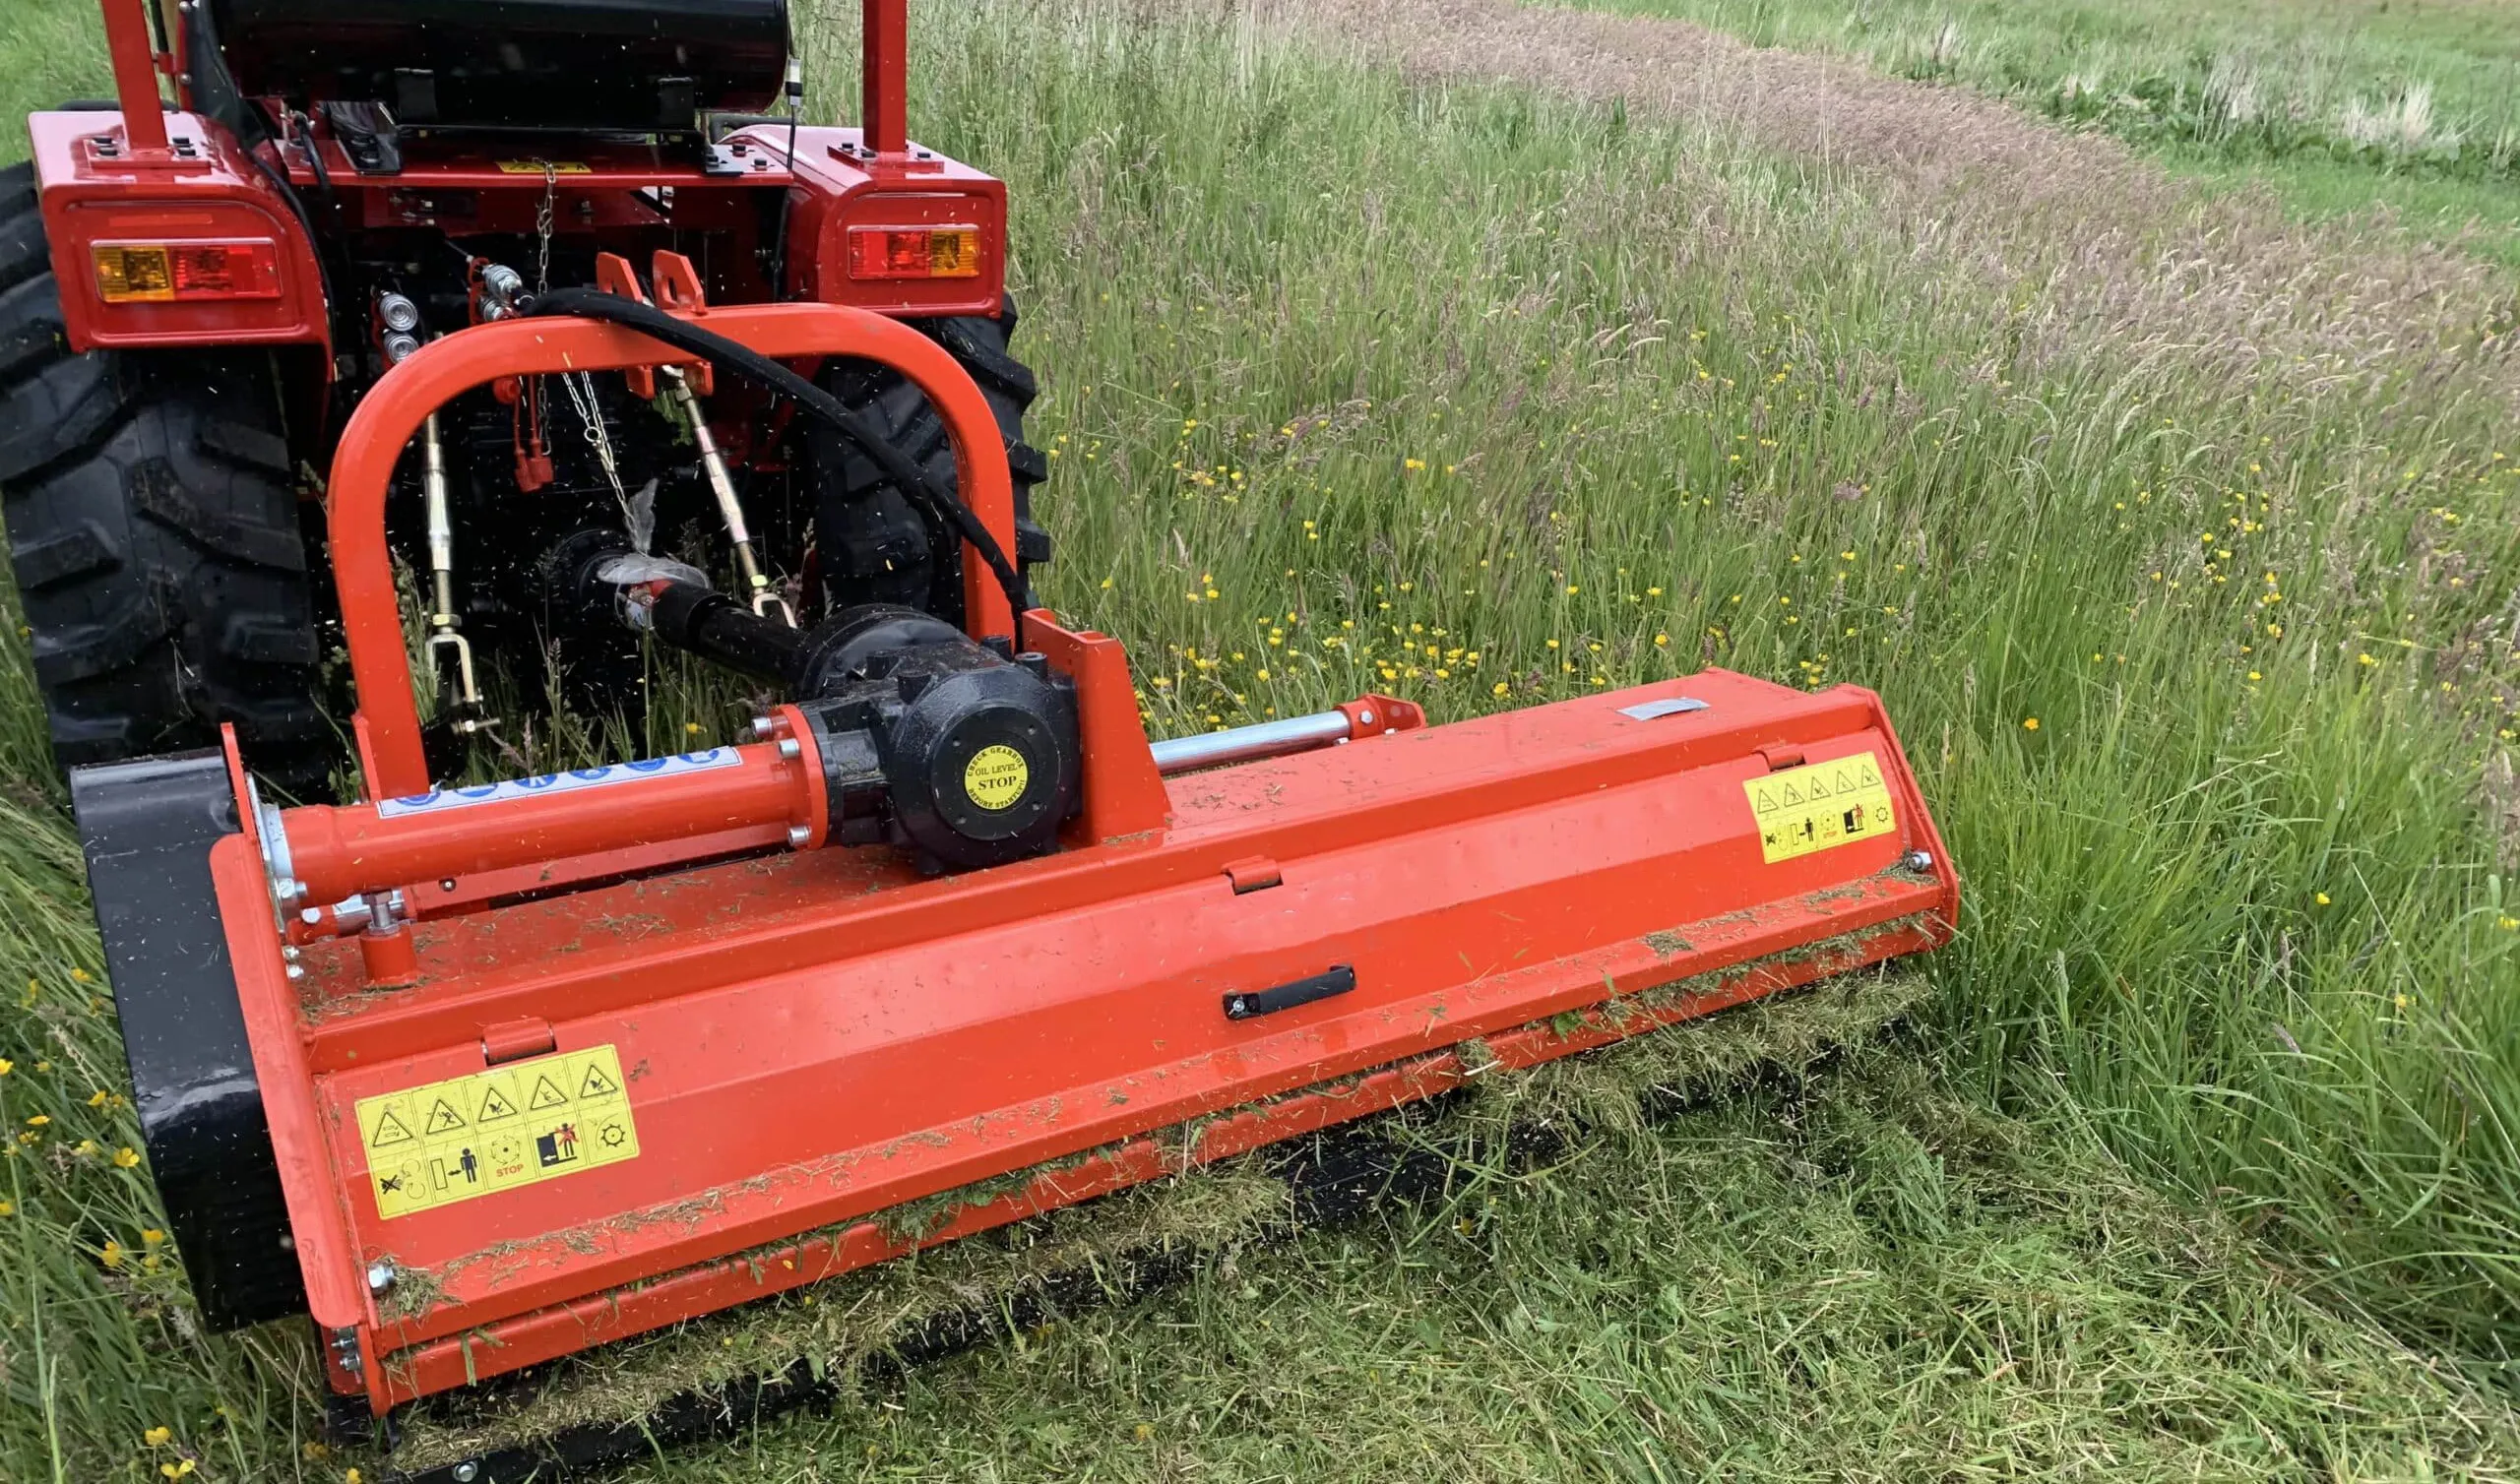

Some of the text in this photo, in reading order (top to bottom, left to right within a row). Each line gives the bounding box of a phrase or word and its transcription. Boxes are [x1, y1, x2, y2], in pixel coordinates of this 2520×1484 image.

[968, 747, 1024, 776] CHECK GEARBOX
[975, 764, 1018, 776] OIL LEVEL
[977, 775, 1017, 790] STOP
[496, 1163, 524, 1177] STOP
